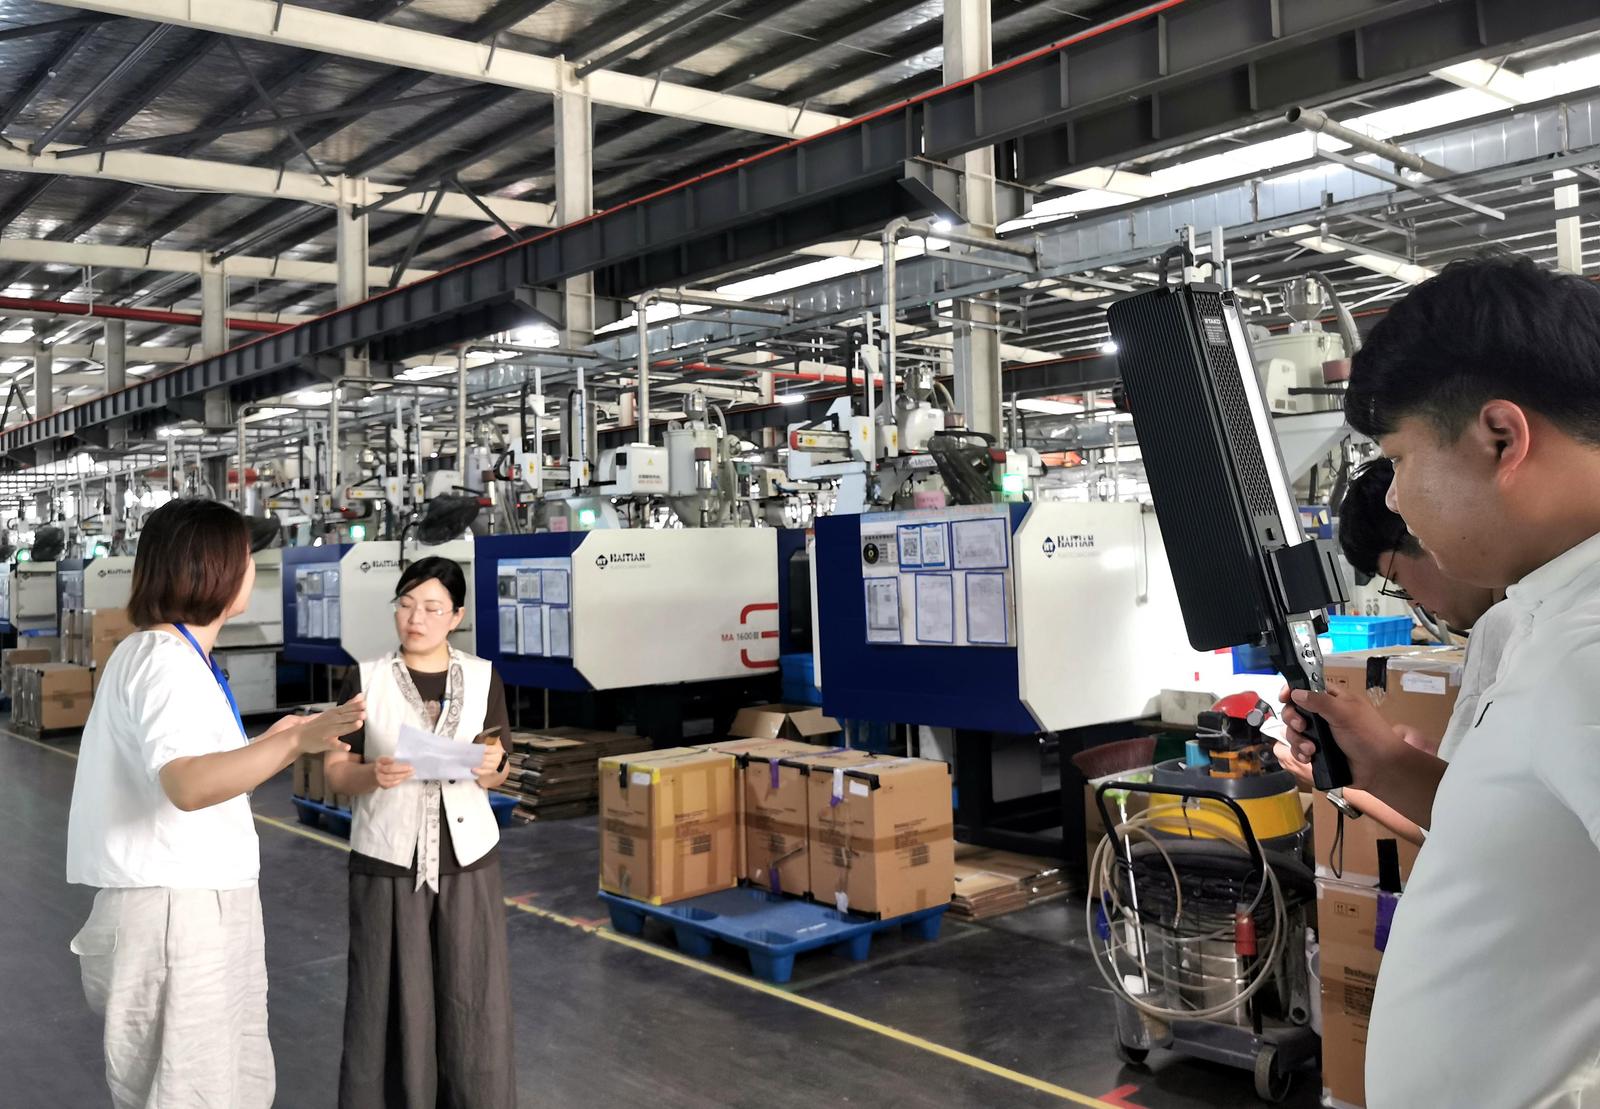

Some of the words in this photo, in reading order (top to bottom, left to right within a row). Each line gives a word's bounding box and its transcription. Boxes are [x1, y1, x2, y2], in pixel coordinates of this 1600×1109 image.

[1057, 535, 1094, 547] HAITIAN
[610, 553, 645, 563] HAITIAN
[721, 633, 734, 641] MA
